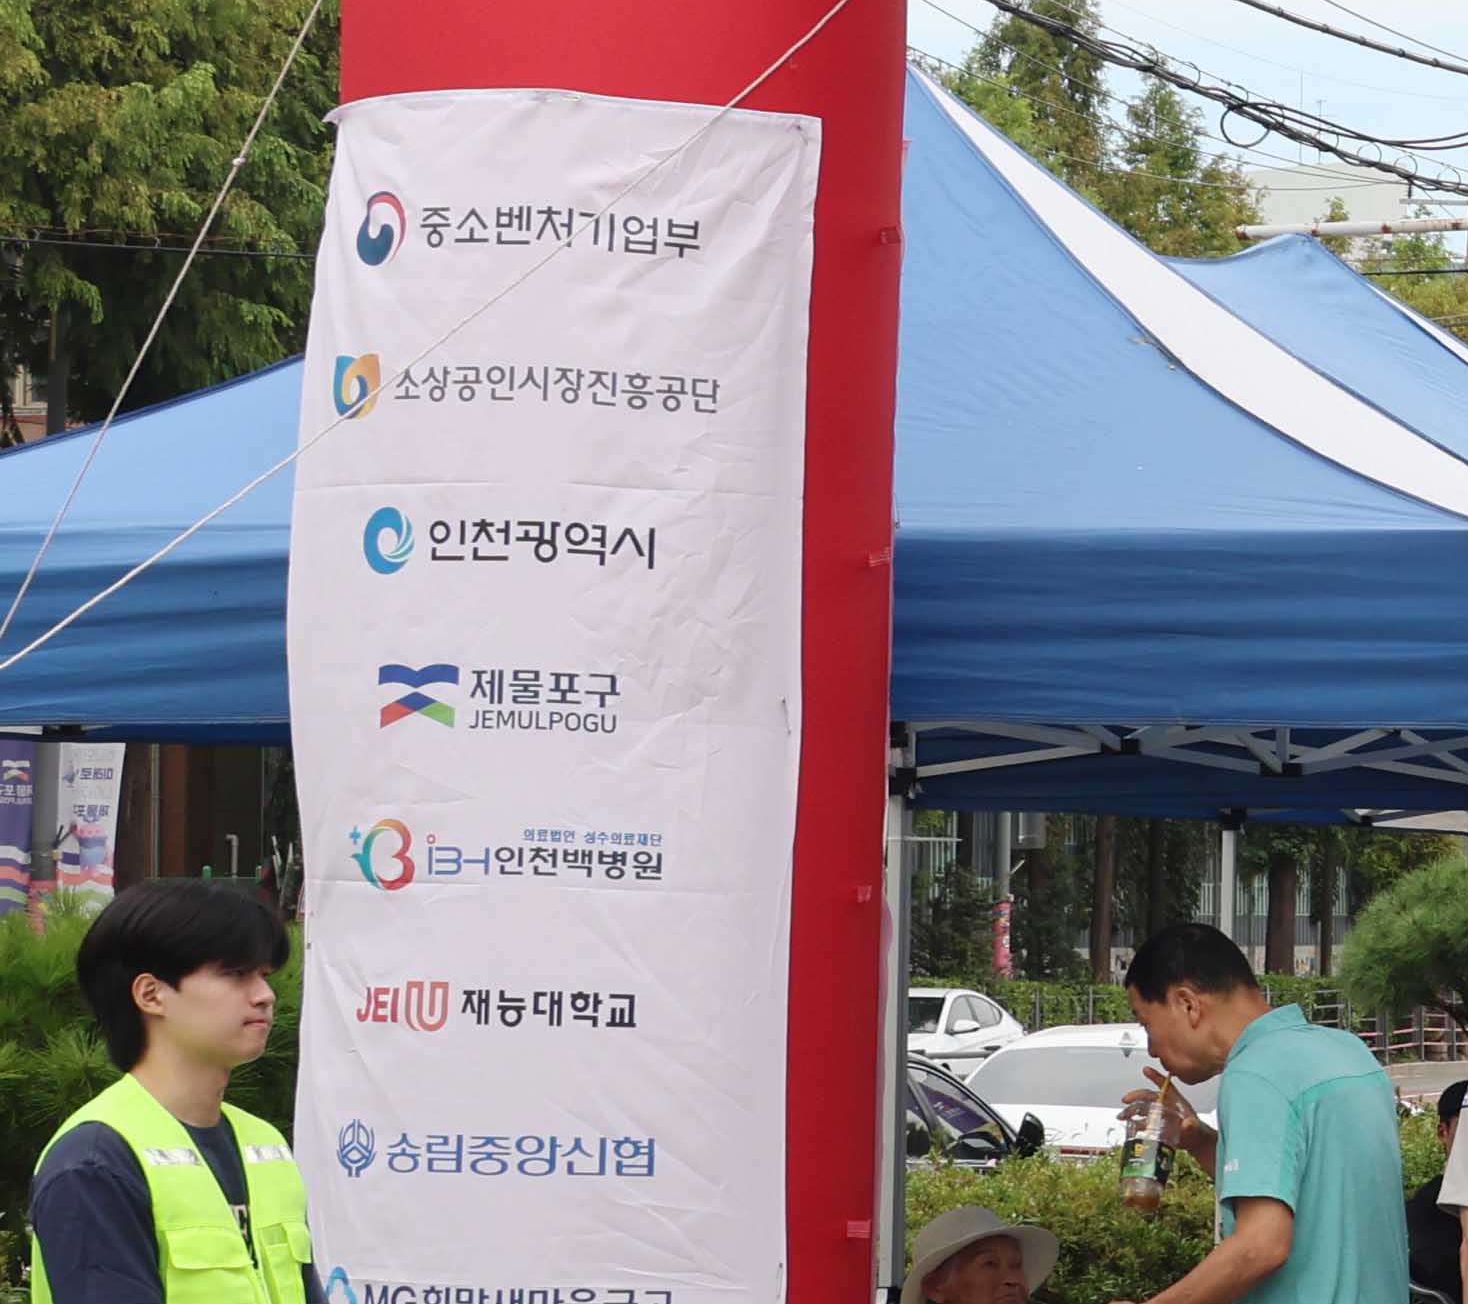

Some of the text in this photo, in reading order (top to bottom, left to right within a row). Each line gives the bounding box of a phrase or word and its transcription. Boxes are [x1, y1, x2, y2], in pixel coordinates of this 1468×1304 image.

[421, 205, 701, 258] 중소벤처기업부
[395, 364, 719, 414] 소상공인시장진흥공단
[430, 519, 655, 569] 인천광역시
[470, 669, 621, 709] 제물포구
[470, 711, 616, 733] JEMULPOGU
[524, 829, 576, 843] 의료법인
[462, 990, 636, 1027] 재능대학교
[388, 1133, 654, 1176] 송림중앙신협
